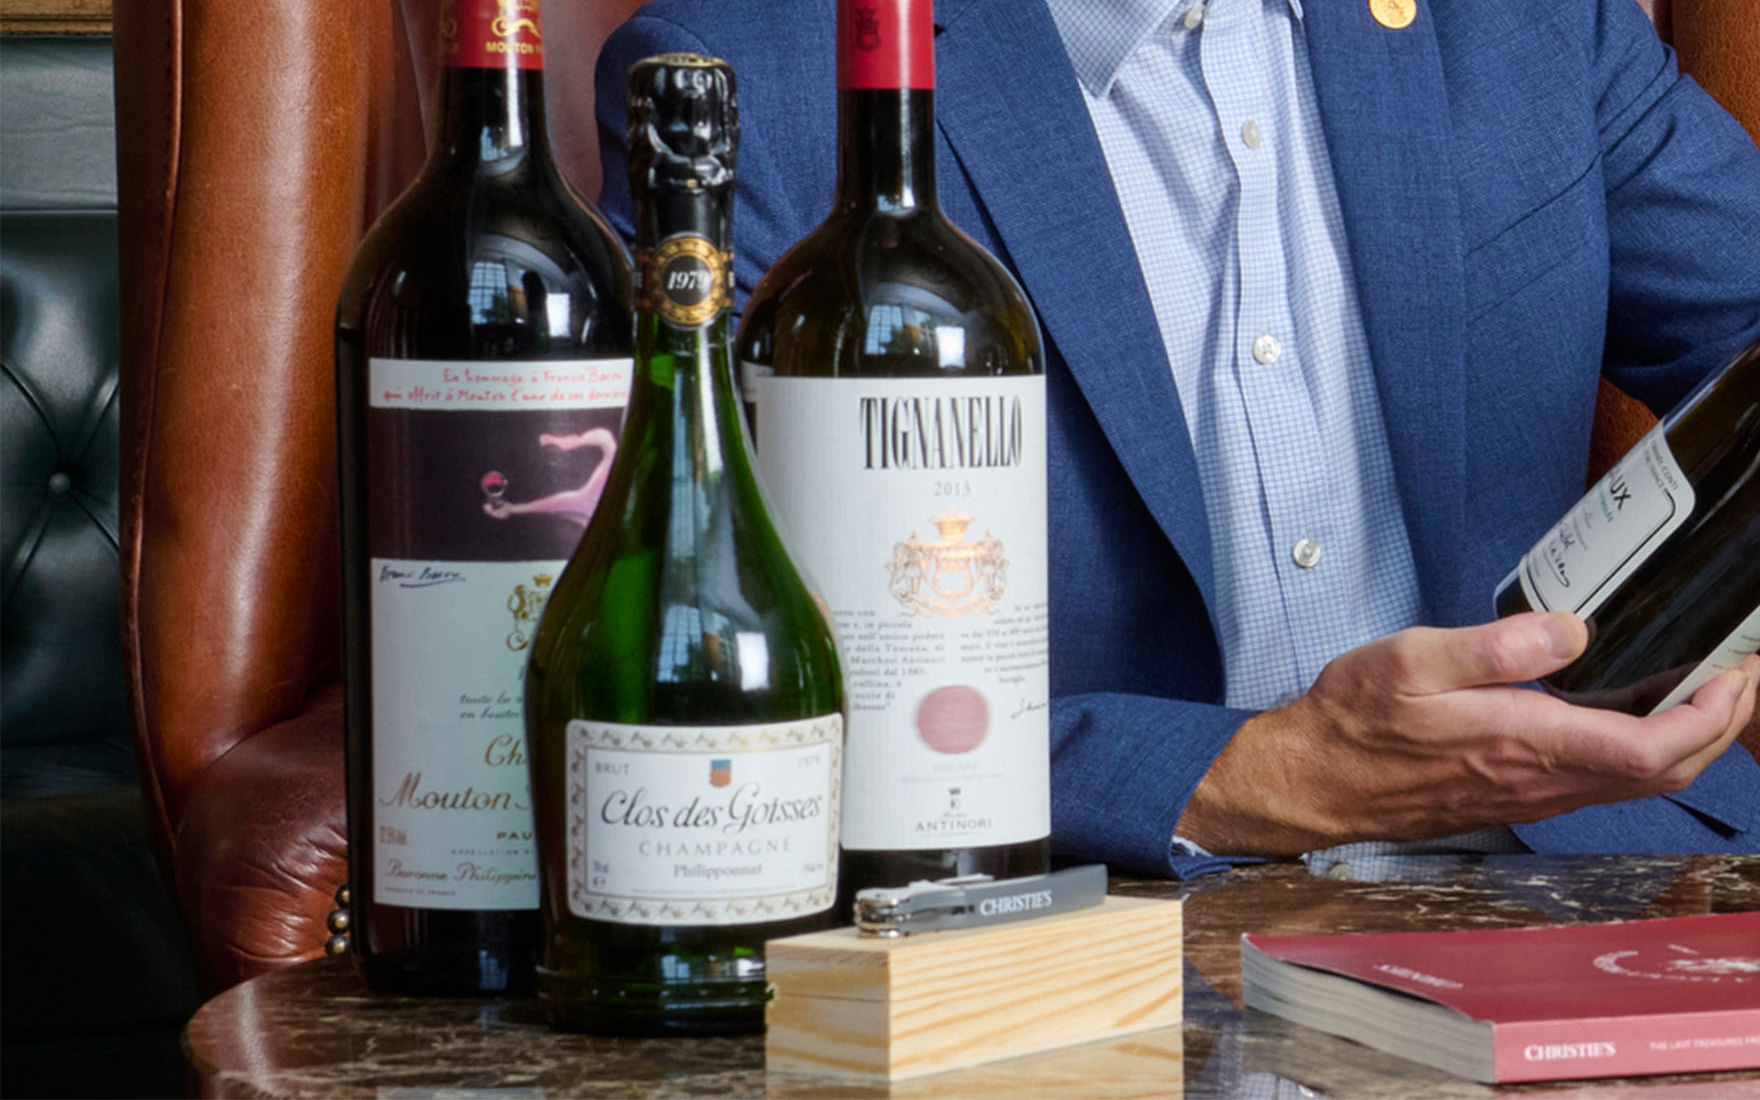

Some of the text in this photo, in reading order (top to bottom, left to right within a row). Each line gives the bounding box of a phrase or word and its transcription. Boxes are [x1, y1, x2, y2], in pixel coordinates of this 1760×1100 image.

[859, 394, 1023, 471] TIGNANELLO
[595, 761, 630, 776] BRUT
[379, 771, 512, 812] Mouton
[600, 780, 824, 835] Clos des Goisses
[915, 817, 993, 832] ANTINORI
[637, 835, 792, 858] CHAMPAGNE
